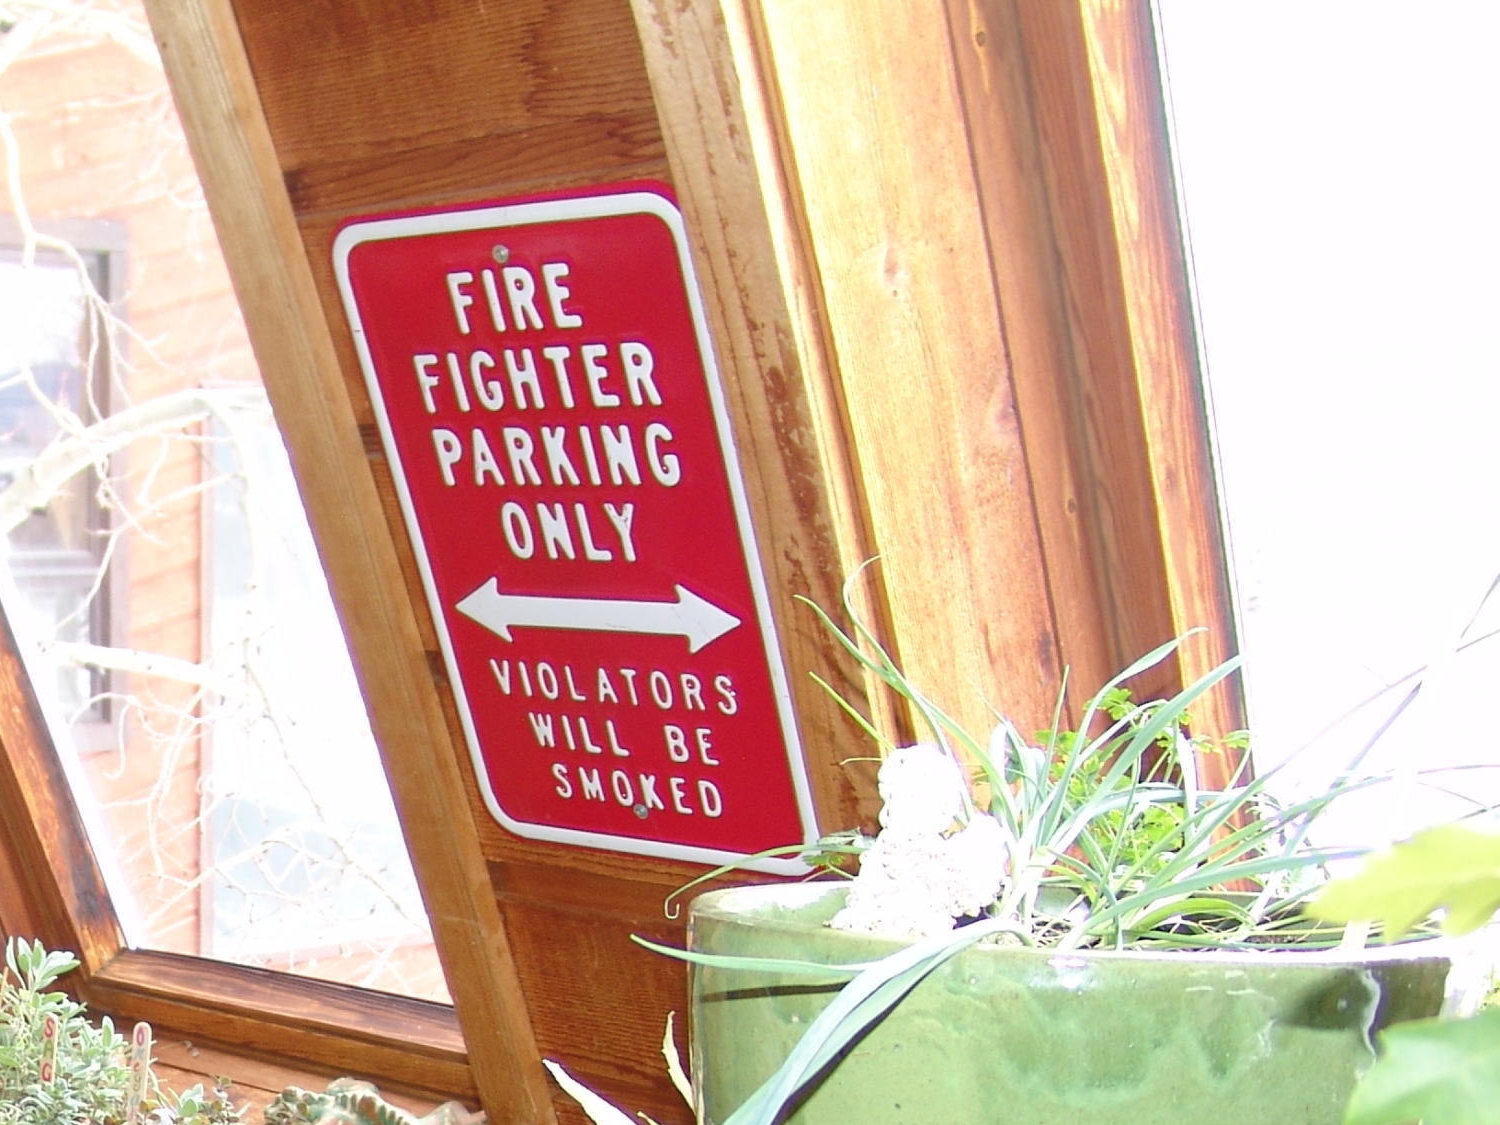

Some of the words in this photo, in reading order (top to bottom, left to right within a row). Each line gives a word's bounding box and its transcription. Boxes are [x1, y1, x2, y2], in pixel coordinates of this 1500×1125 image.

[446, 261, 583, 335] FIRE
[413, 341, 663, 413] FIGHTER
[433, 422, 682, 488] PARKING
[501, 502, 637, 562] ONLY
[489, 658, 739, 716] VIOLATORS
[528, 712, 631, 758] WILL
[664, 724, 720, 766] BE
[552, 763, 724, 819] SMOKED
